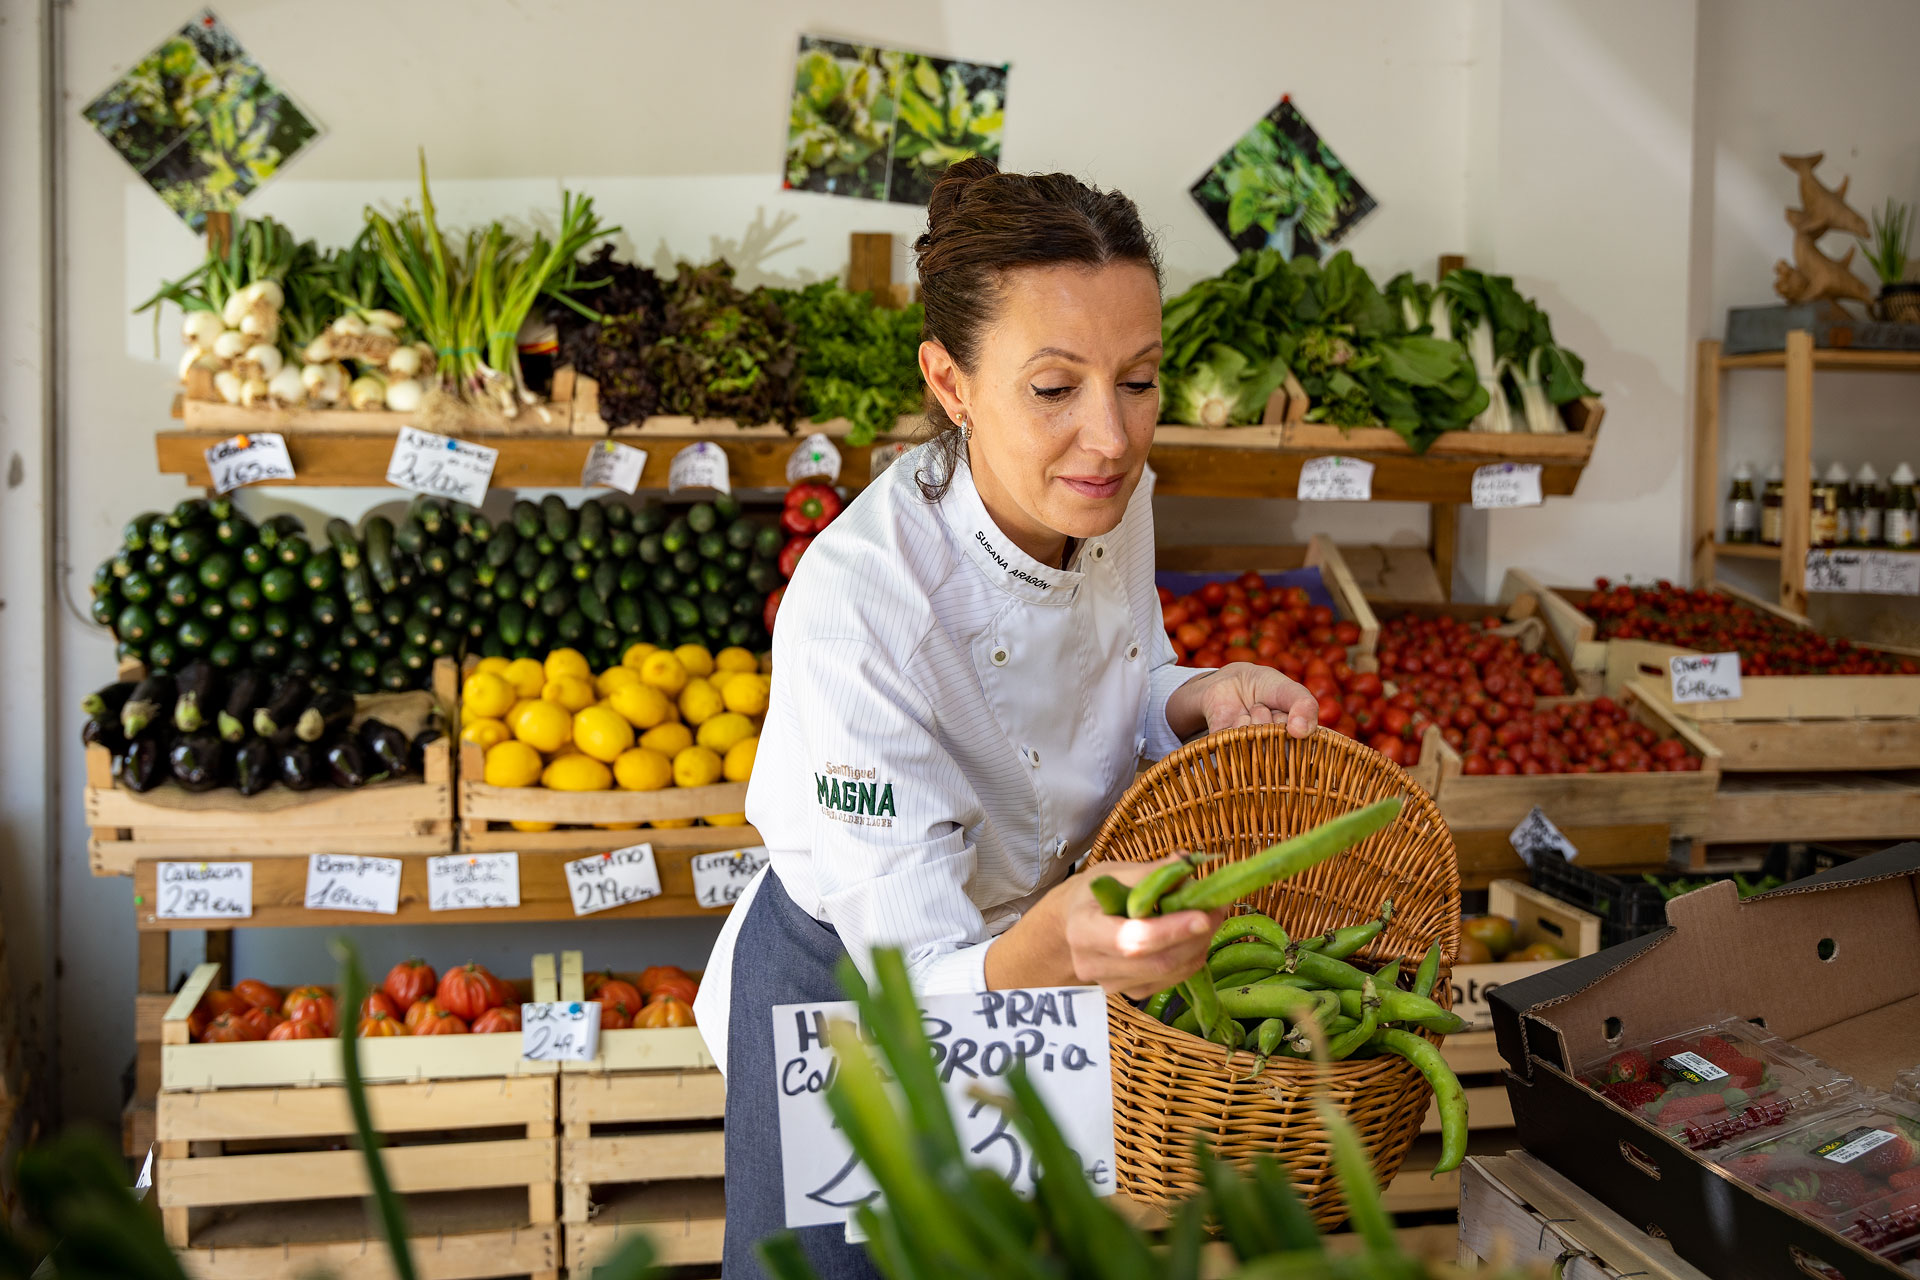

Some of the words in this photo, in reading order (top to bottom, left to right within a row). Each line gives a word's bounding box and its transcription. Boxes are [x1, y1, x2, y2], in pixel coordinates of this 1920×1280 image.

[975, 530, 1009, 571] SUSANA
[1008, 568, 1051, 590] ARAGÓN
[814, 772, 897, 818] MAGNA
[573, 849, 643, 876] Pepino
[973, 990, 1097, 1030] PRAT
